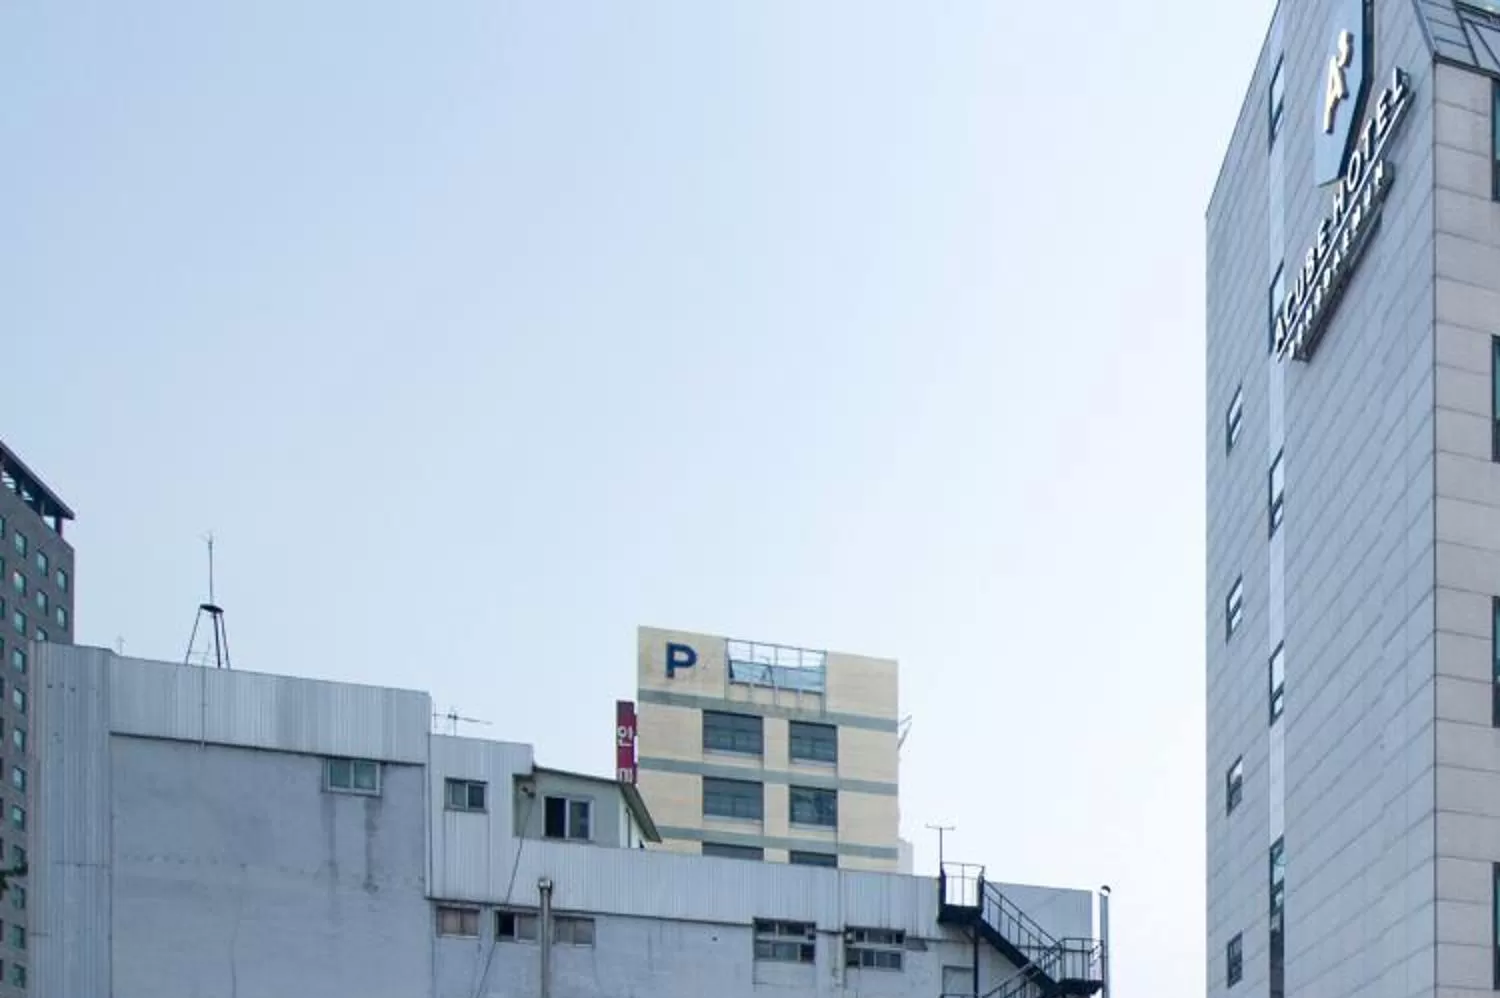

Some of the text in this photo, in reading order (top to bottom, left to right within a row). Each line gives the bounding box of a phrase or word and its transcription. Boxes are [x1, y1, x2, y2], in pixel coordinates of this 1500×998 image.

[1273, 66, 1410, 355] ACUBE HOTEL
[665, 641, 698, 679] P
